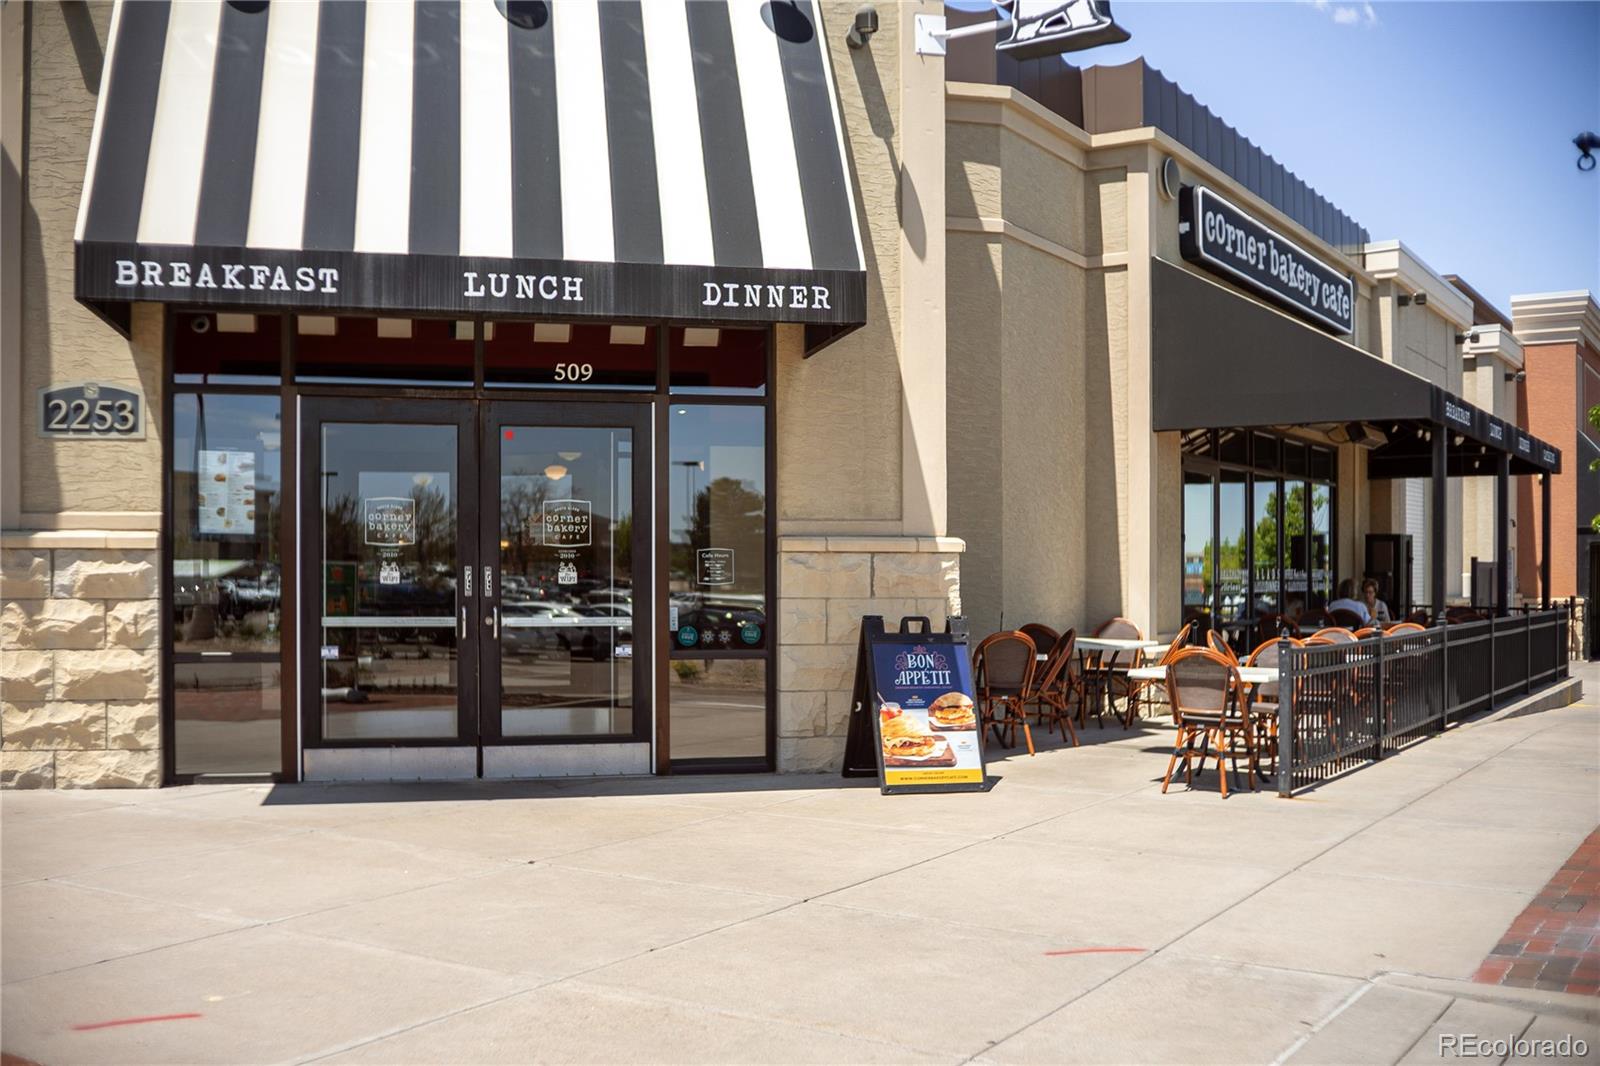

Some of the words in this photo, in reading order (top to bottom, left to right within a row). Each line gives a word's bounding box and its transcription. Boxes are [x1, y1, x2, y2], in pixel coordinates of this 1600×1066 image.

[1204, 210, 1267, 270] corner
[1268, 239, 1321, 307] bakery
[1321, 281, 1351, 320] cafe
[115, 259, 339, 293] BREAKFAST
[463, 271, 584, 301] LUNCH
[702, 282, 832, 310] DINNER
[553, 362, 593, 381] 509
[47, 399, 135, 431] 2253
[368, 512, 412, 521] corner
[546, 514, 589, 523] corner
[368, 521, 412, 533] bakery
[546, 523, 588, 534] bakery
[906, 653, 936, 669] BON
[894, 668, 952, 686] APPÉTIT
